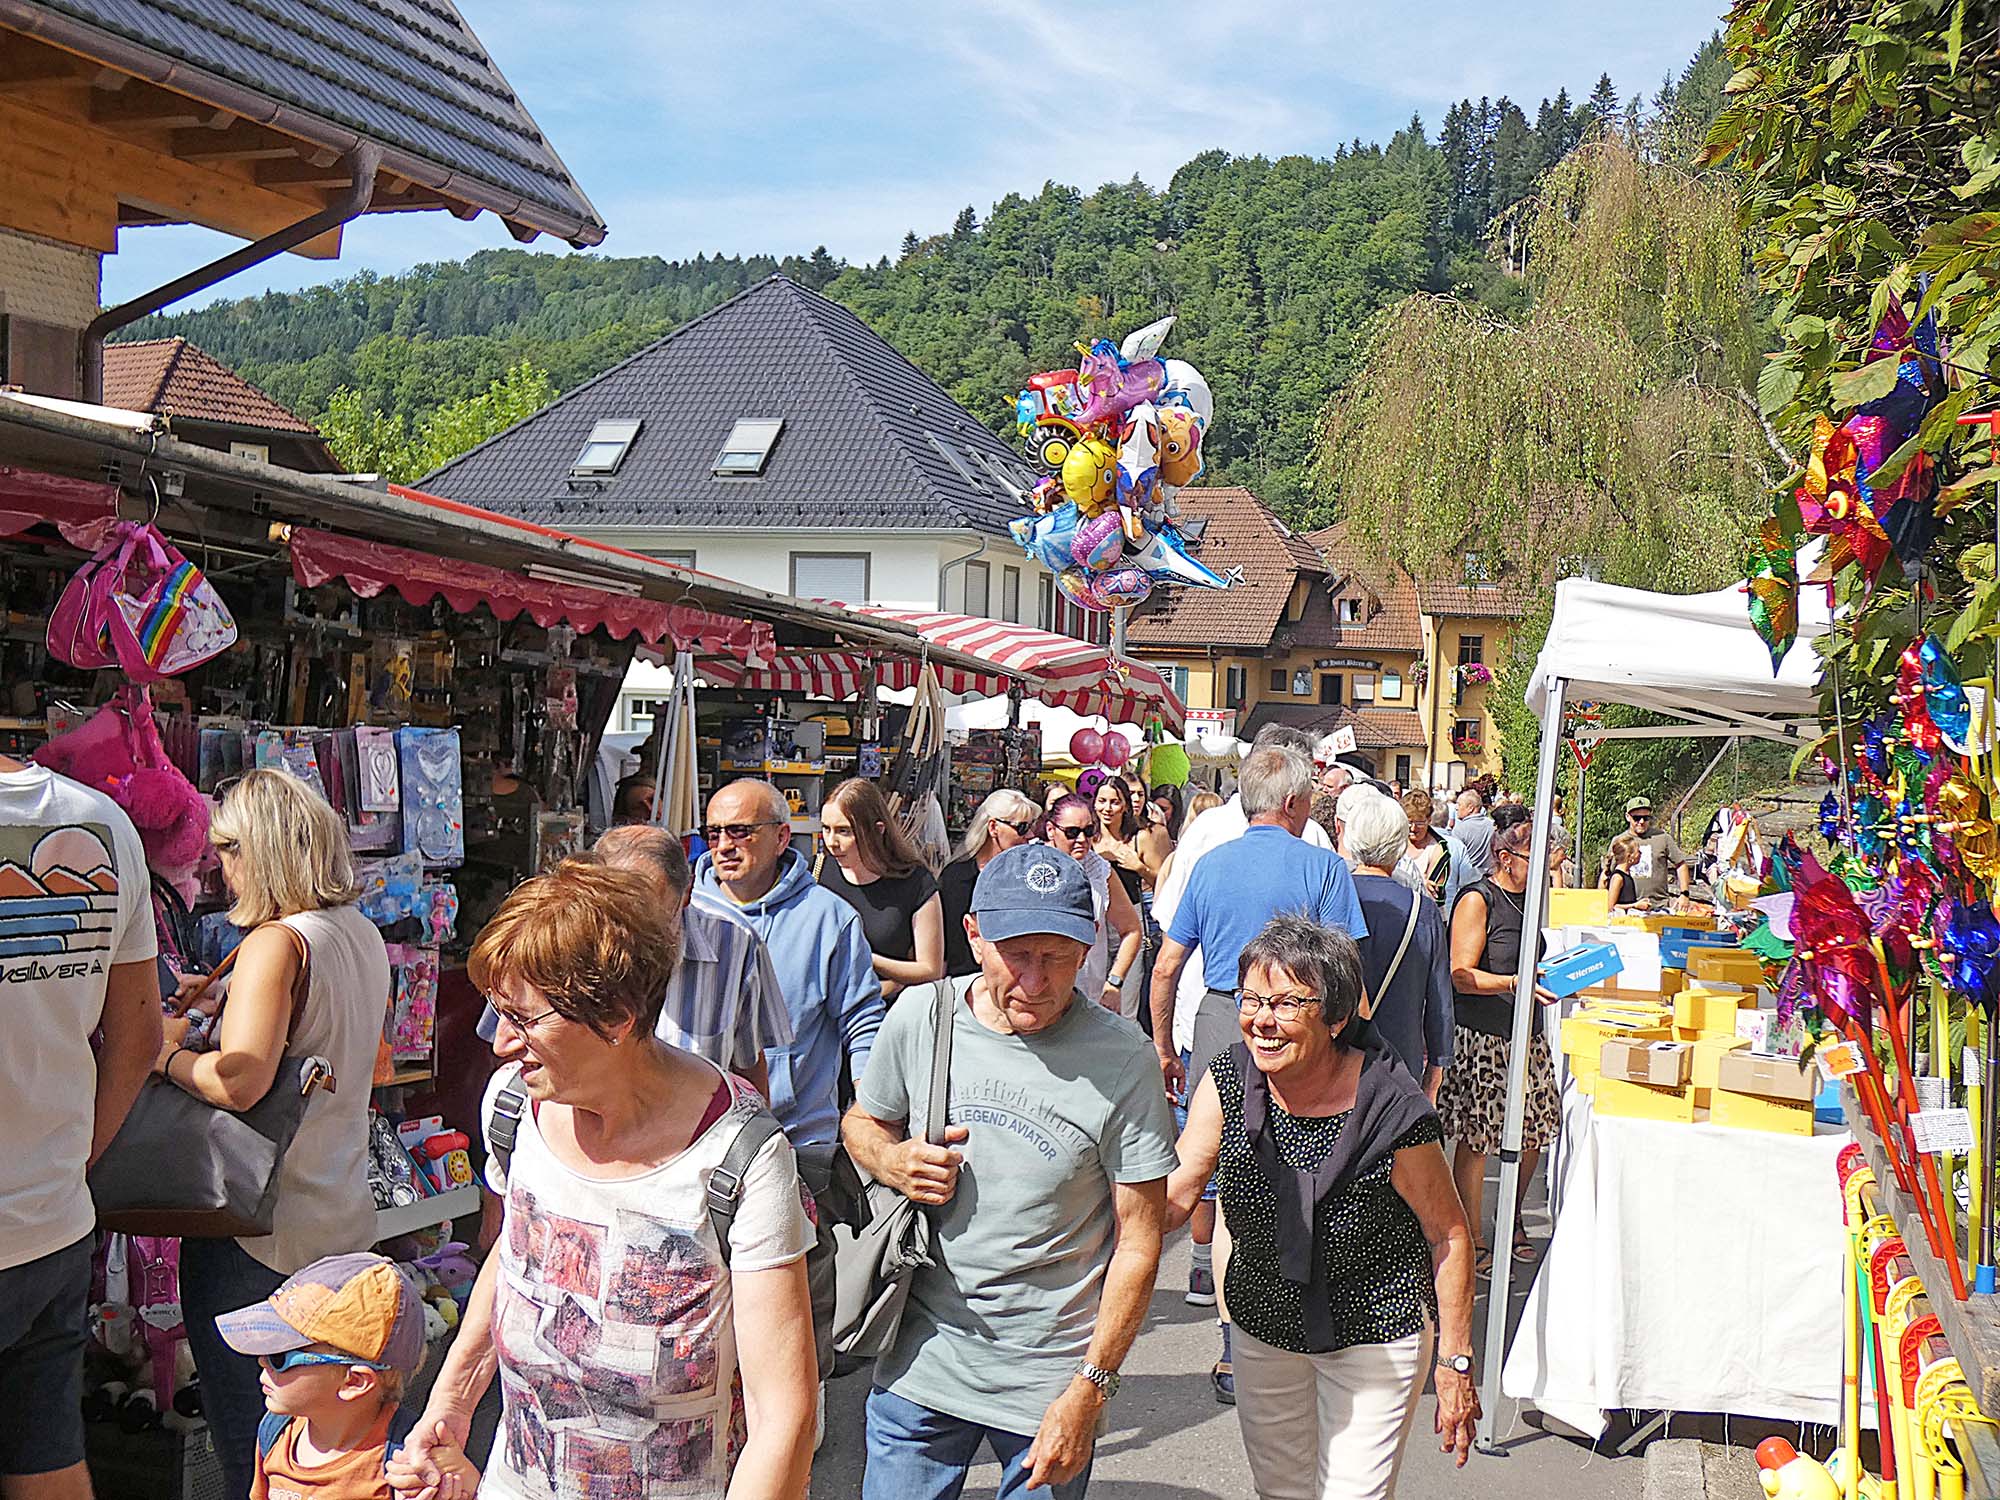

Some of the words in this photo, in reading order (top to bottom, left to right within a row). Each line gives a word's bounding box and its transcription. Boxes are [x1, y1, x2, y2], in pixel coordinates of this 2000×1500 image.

[733, 759, 761, 768] bruder
[1575, 960, 1604, 980] Hermes
[1766, 1099, 1806, 1111] PACKSET
[958, 1109, 1008, 1127] LEGEND
[1008, 1118, 1057, 1162] AVIATOR
